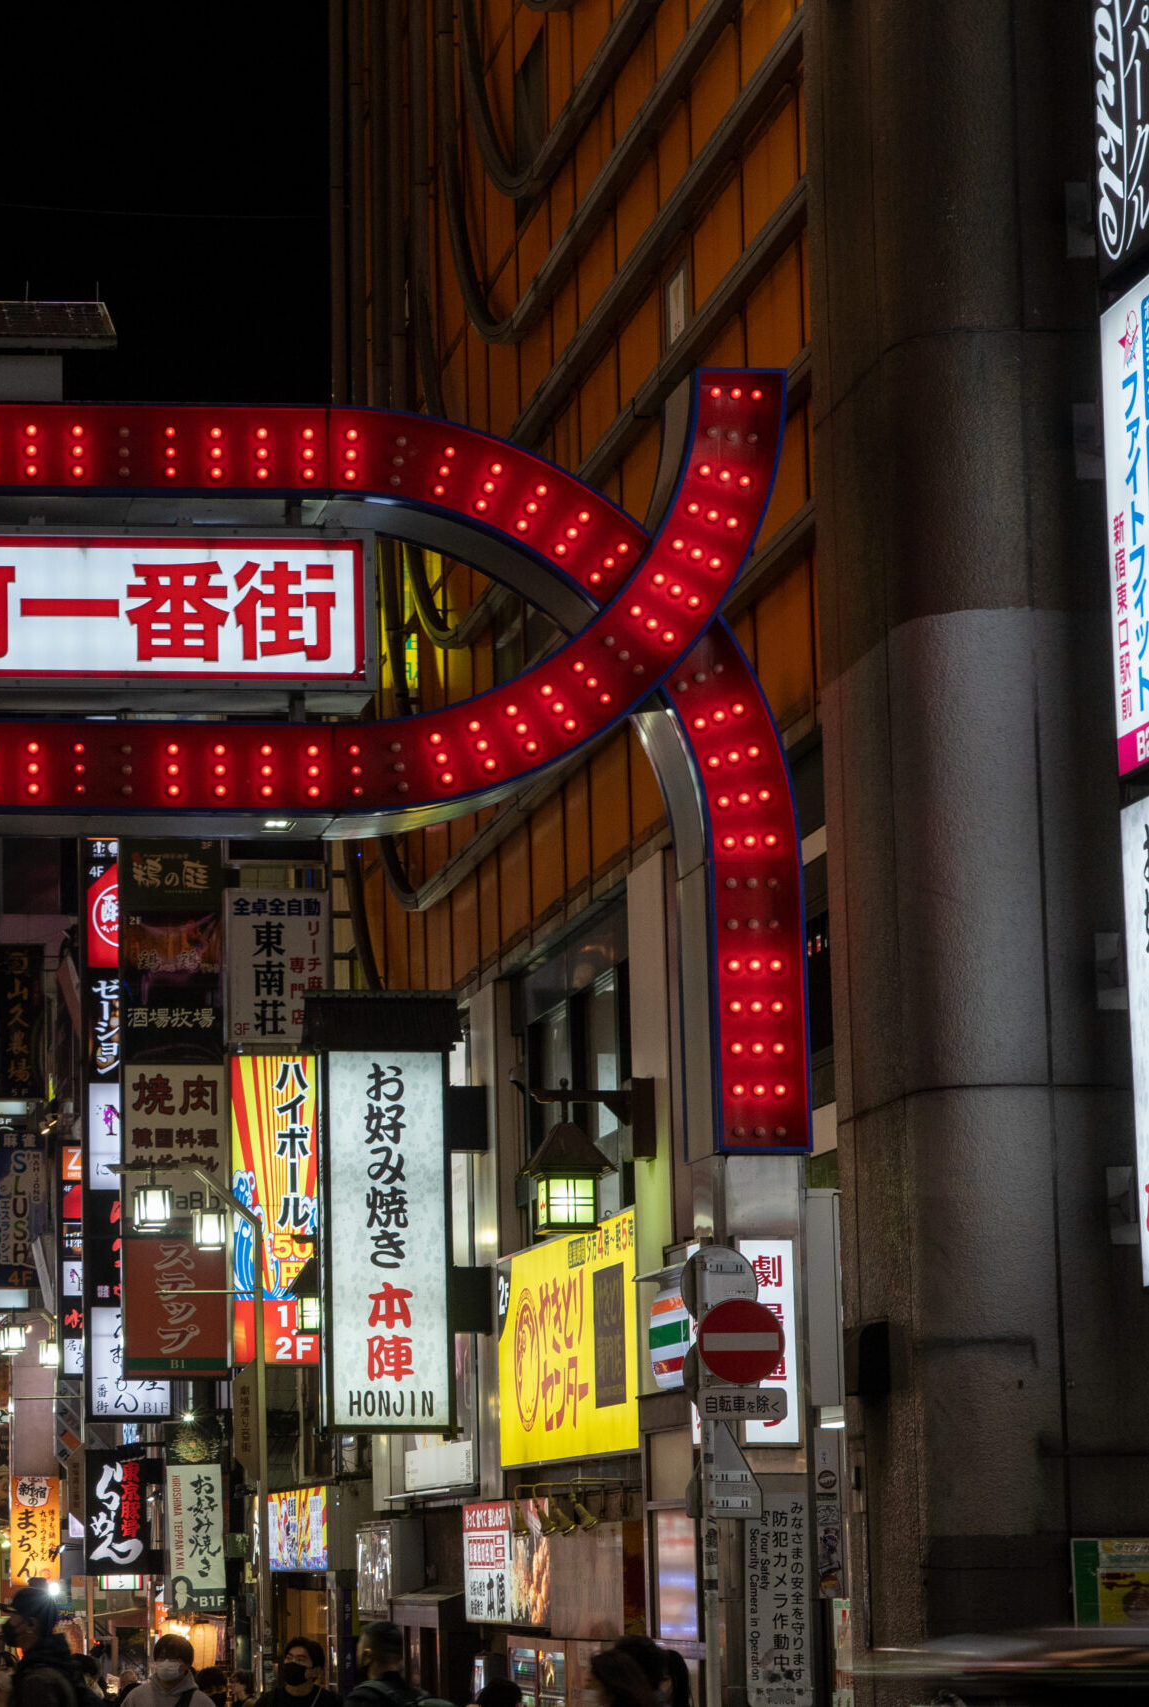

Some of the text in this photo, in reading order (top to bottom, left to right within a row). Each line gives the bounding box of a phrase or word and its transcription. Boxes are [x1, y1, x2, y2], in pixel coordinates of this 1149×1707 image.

[1113, 512, 1133, 721] 新宿東口駅前
[89, 865, 104, 878] 4F
[233, 898, 321, 916] 全卓全自動
[253, 920, 286, 1037] 東南荘
[127, 1007, 216, 1029] 酒場牧場
[234, 1022, 251, 1036] 3F
[132, 1073, 219, 1116] 焼肉
[272, 1059, 313, 1231] ハイボール
[365, 1062, 410, 1269] お好み焼き
[8, 1270, 33, 1286] 4F
[154, 1243, 200, 1354] ステップ
[498, 1275, 510, 1316] 2F
[367, 1281, 414, 1383] 本陣
[538, 1268, 584, 1355] やきとり
[170, 1358, 187, 1369] B1
[275, 1336, 315, 1360] 2F
[94, 1376, 110, 1414] 一番街
[142, 1402, 169, 1414] B1F
[349, 1389, 435, 1418] HONJIN
[541, 1355, 589, 1432] センター
[704, 1395, 781, 1414] 自転車を除く
[121, 1461, 140, 1538] 東京豚骨
[172, 1475, 182, 1516] HIROSHIMA
[186, 1473, 221, 1578] お好み焼き
[758, 1510, 771, 1591] For Your Safety
[199, 1595, 225, 1607] B1F
[748, 1528, 761, 1682] Security Camera in Operation
[772, 1510, 790, 1672] 防犯カメラ作動中
[790, 1501, 806, 1681] みなさまの安全を守ります
